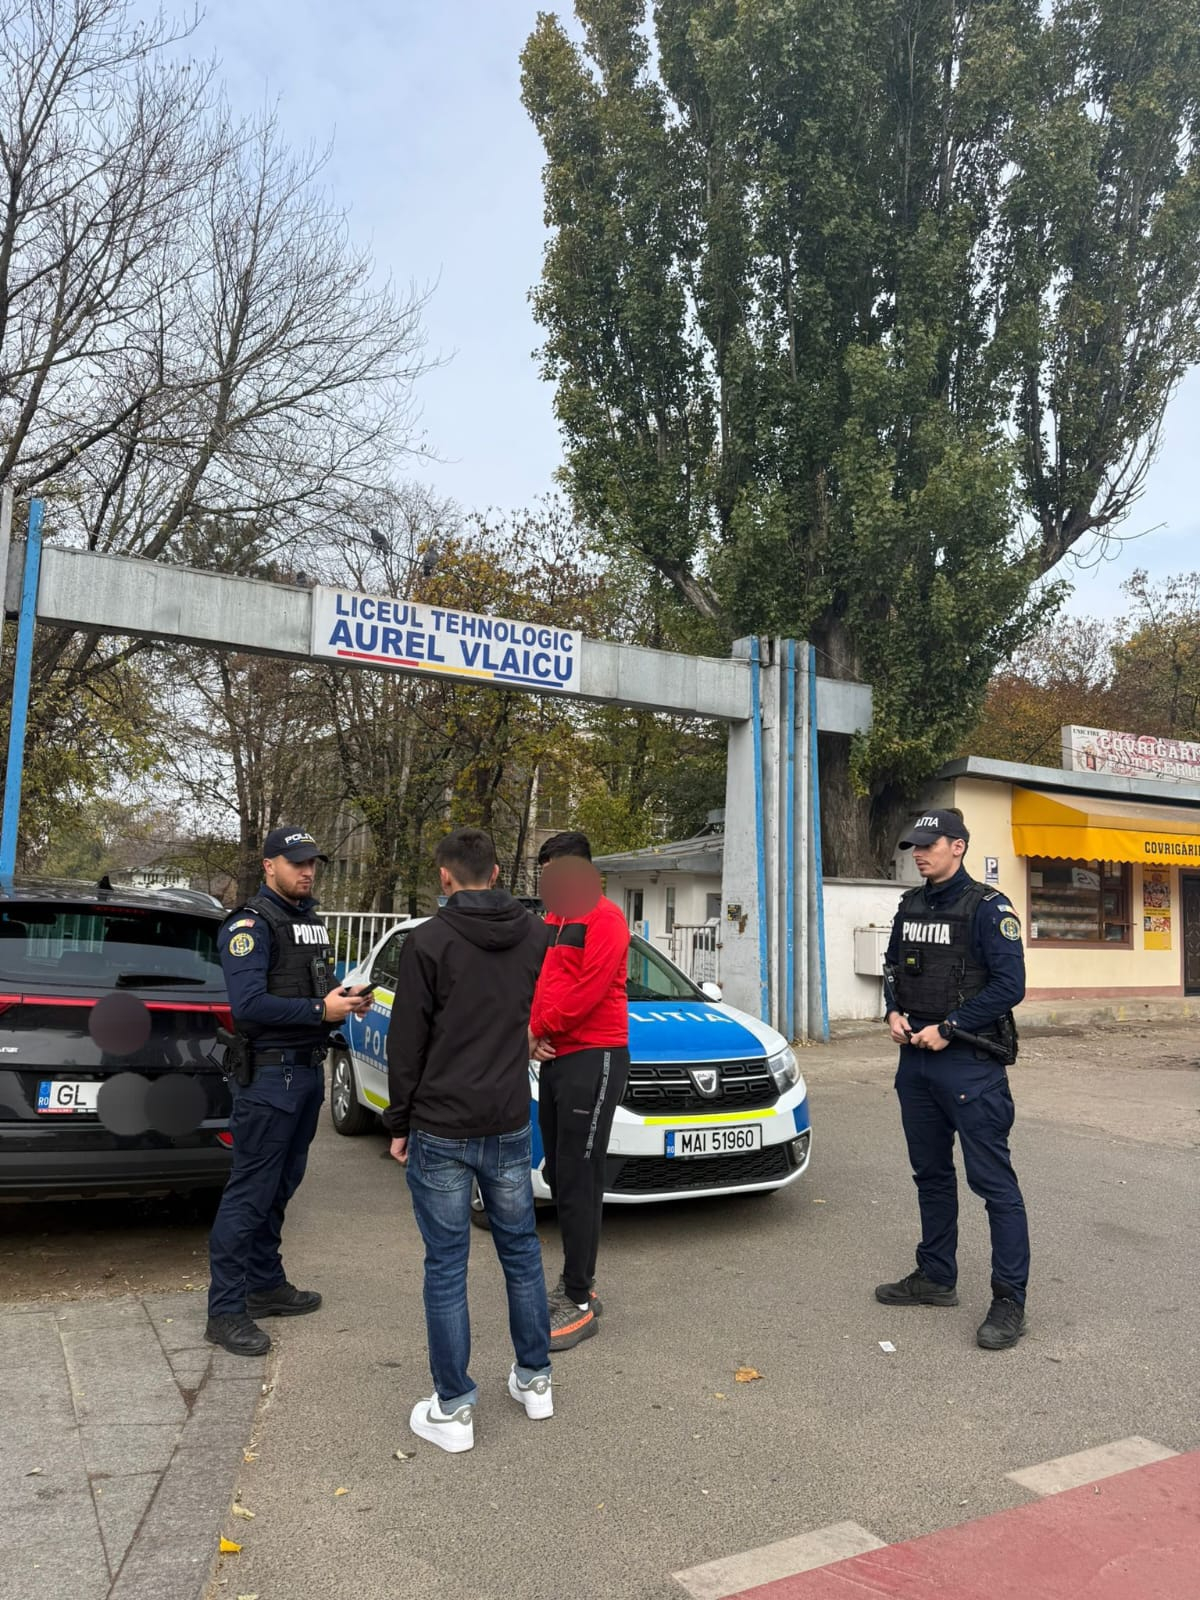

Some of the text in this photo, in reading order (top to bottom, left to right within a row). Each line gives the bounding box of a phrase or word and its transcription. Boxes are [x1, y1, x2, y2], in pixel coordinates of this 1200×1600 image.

[336, 594, 573, 652] LICEUL TEHNOLOGIC
[328, 619, 573, 681] AUREL VLAICU
[914, 816, 939, 829] LITIA
[987, 858, 997, 873] P
[902, 921, 951, 945] POLITIA
[627, 1012, 735, 1024] LITIA
[364, 1025, 388, 1061] POL
[38, 1084, 87, 1106] RO GL
[681, 1133, 706, 1153] MAI
[711, 1129, 754, 1151] 51960
